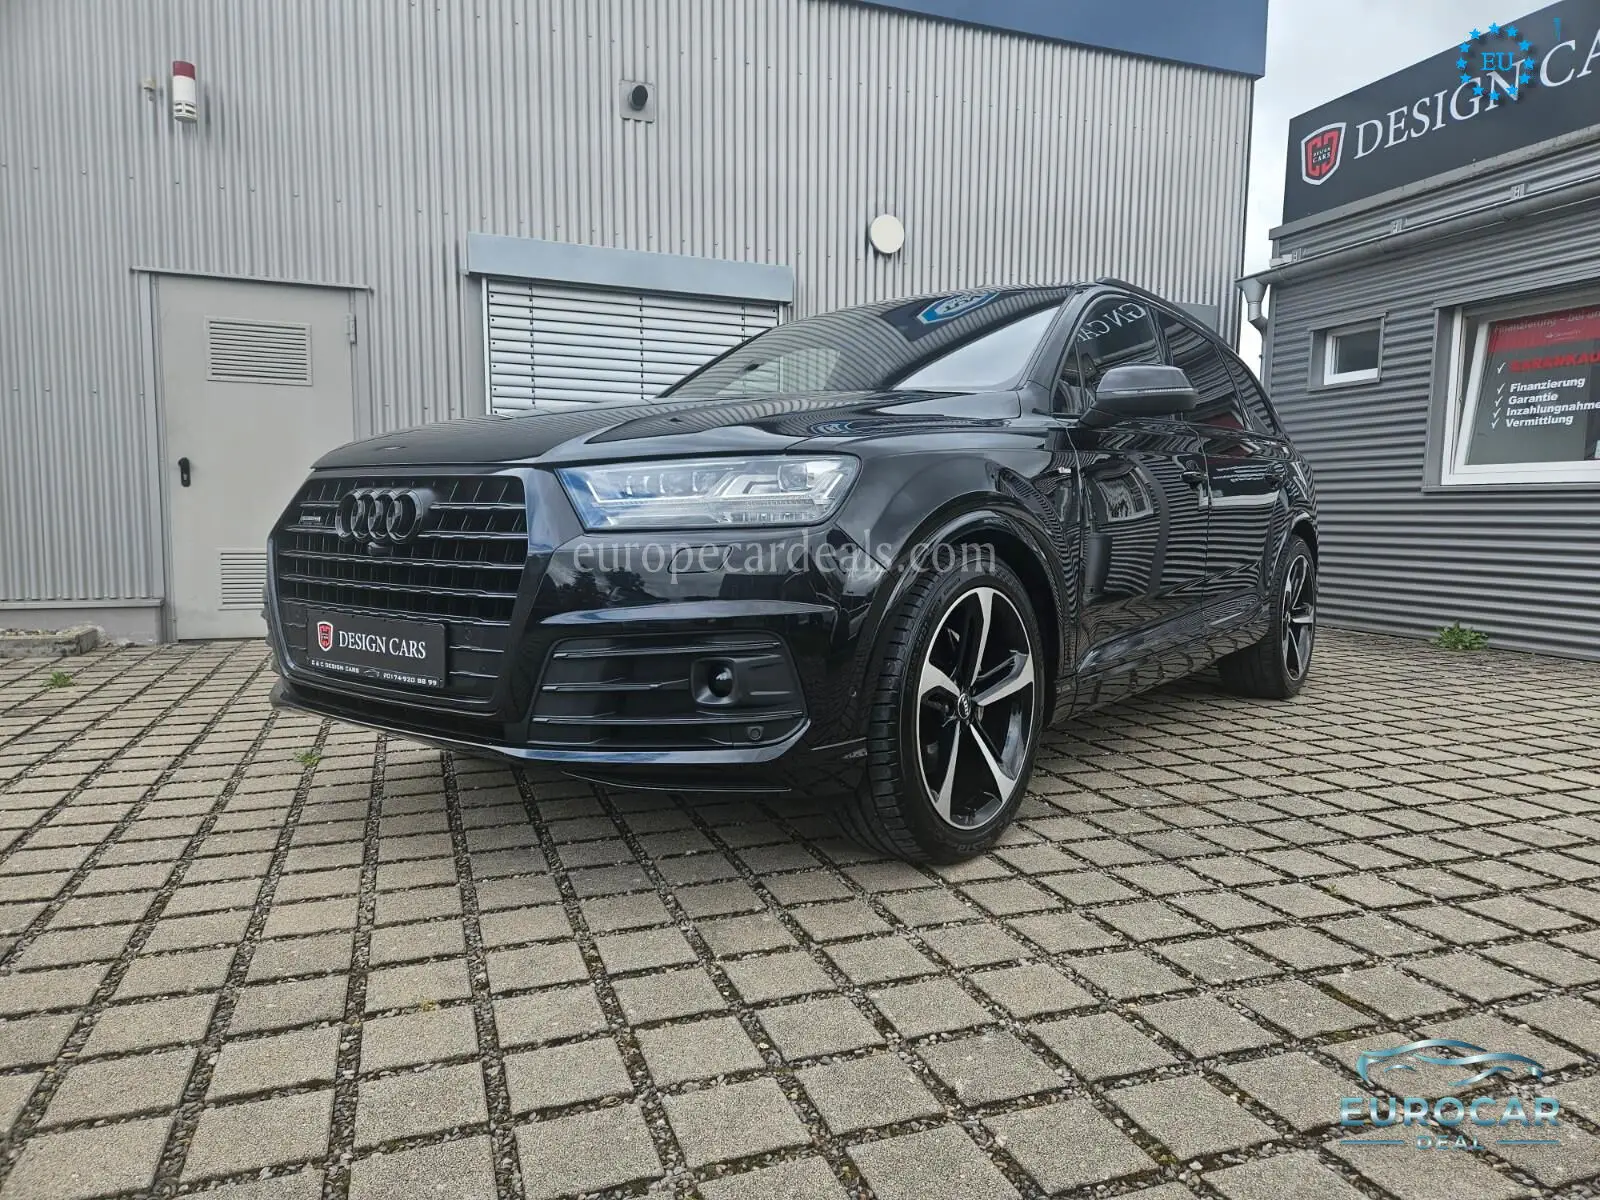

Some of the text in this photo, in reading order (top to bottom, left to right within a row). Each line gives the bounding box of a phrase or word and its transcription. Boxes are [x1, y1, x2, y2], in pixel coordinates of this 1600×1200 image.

[1354, 59, 1526, 160] DESIGN
[1510, 377, 1586, 393] Finanzierung
[1508, 392, 1559, 405] Garantie
[1506, 401, 1600, 416] Inzahlungnahme
[1505, 415, 1574, 427] Vermittlung
[338, 630, 386, 654] DESIGN
[389, 637, 426, 659] CARS
